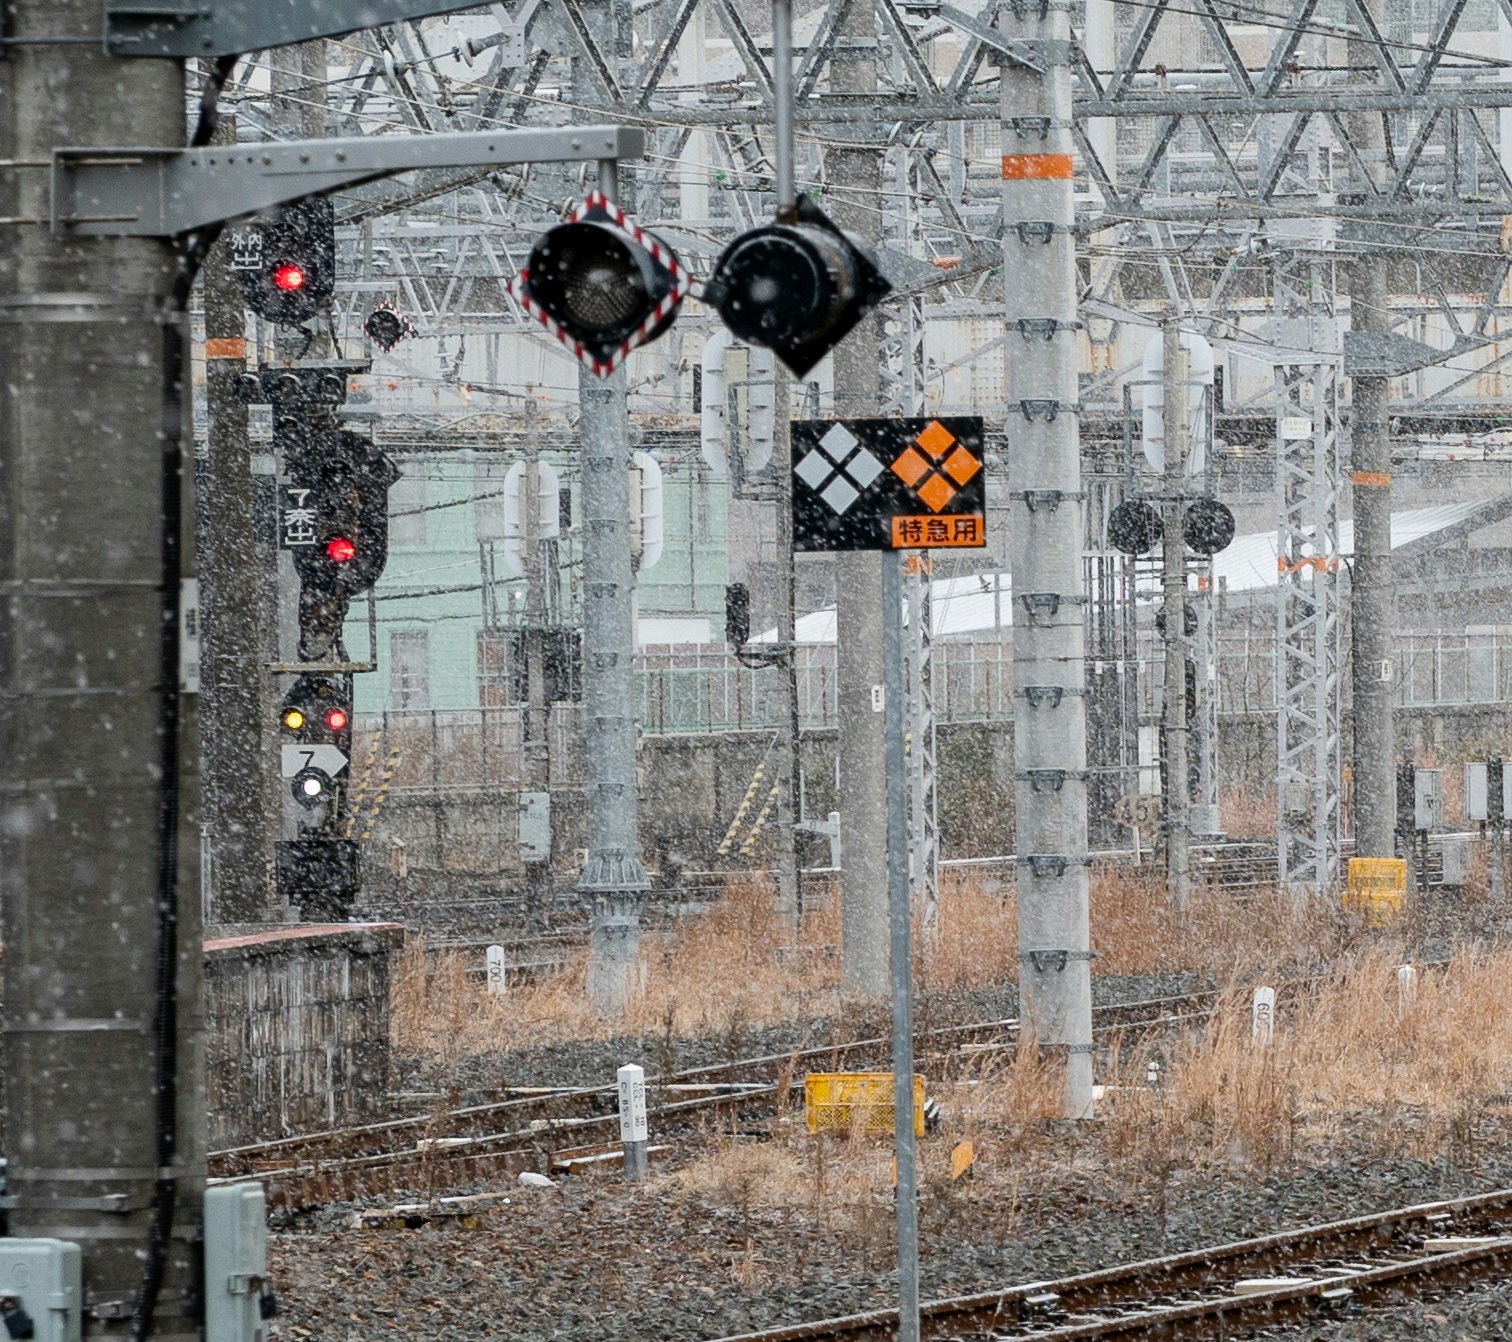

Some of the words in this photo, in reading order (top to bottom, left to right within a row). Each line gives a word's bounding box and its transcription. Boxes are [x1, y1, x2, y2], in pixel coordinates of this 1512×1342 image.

[899, 519, 977, 543] 特急用
[299, 750, 316, 769] 7
